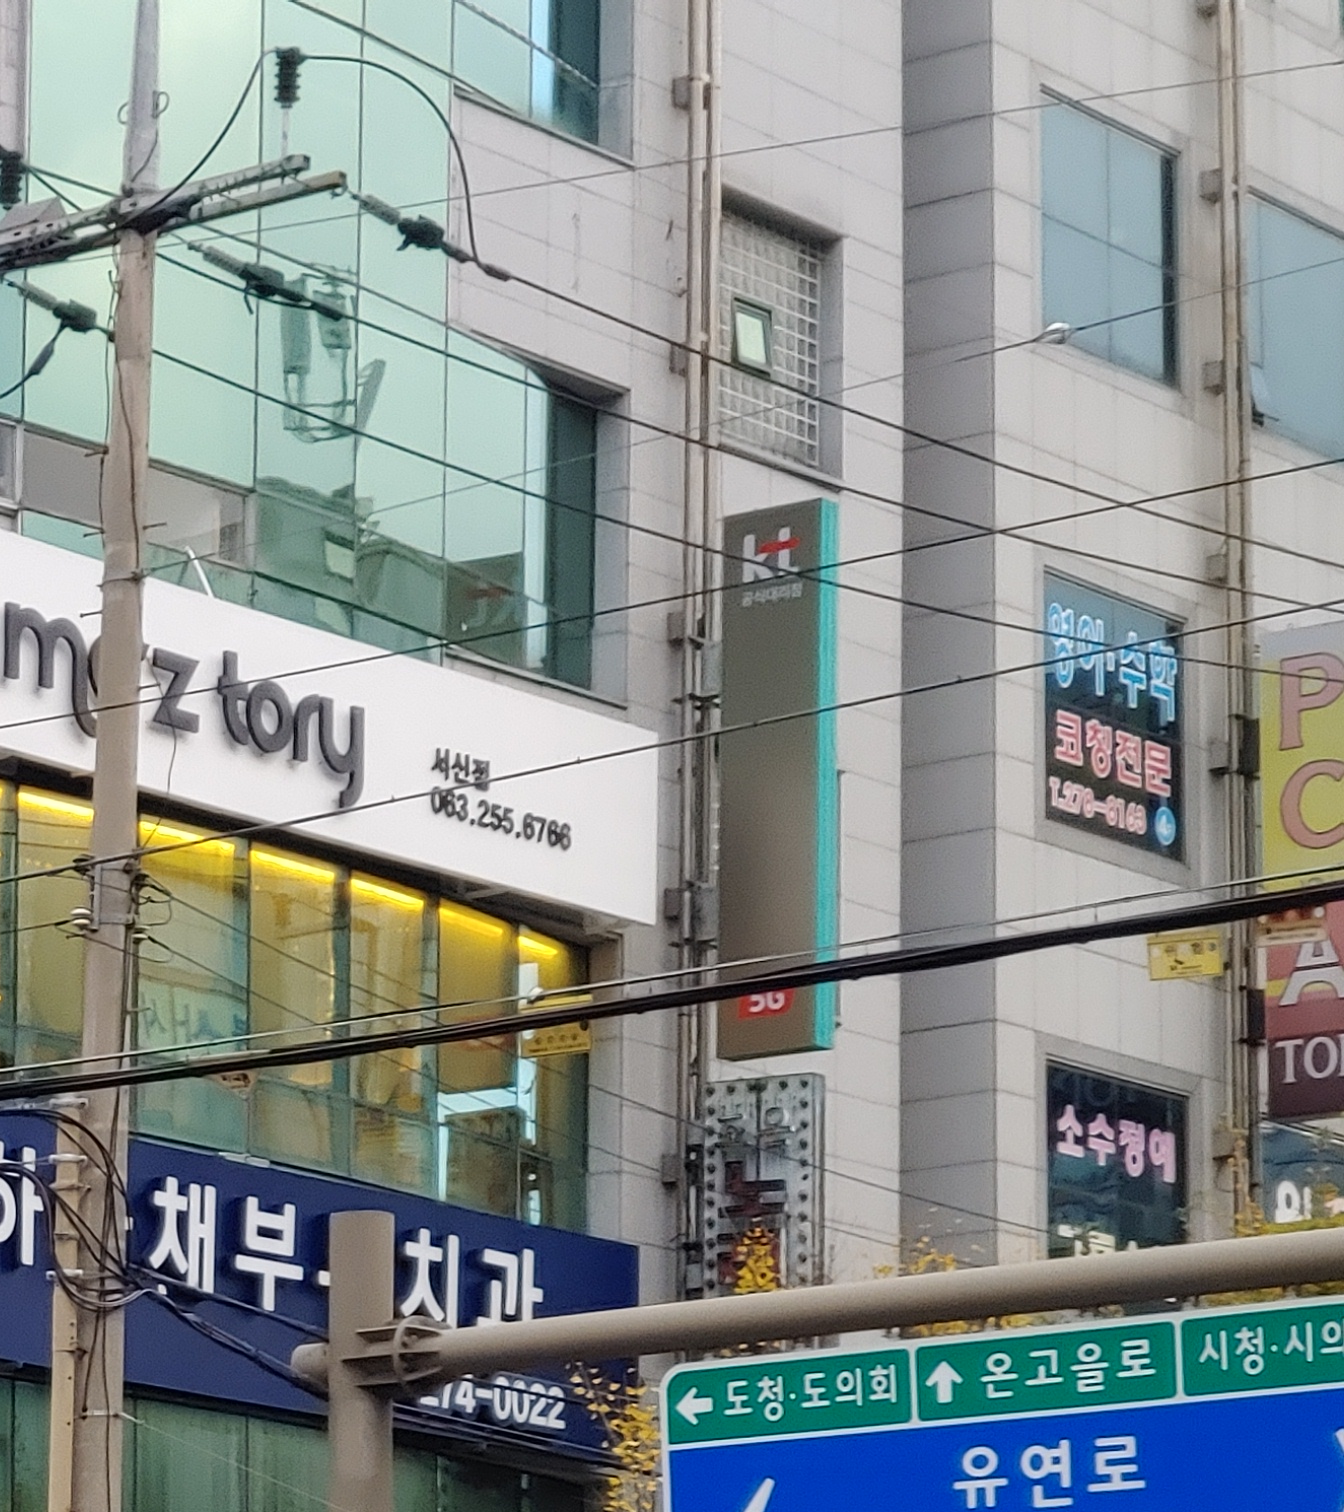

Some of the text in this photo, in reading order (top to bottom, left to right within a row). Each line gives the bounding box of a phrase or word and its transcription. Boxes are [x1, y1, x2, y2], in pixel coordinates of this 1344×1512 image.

[742, 527, 801, 583] kt
[216, 651, 365, 808] tory
[1055, 709, 1172, 797] 코칭전문
[431, 747, 491, 791] 서신점
[430, 786, 572, 852] 063.255.6766
[1274, 1035, 1344, 1084] TO
[1056, 1103, 1176, 1184] 소수정예
[723, 1363, 902, 1422] 도청·도의회
[979, 1345, 1159, 1400] 온고을로
[952, 1434, 1150, 1511] 유연로
